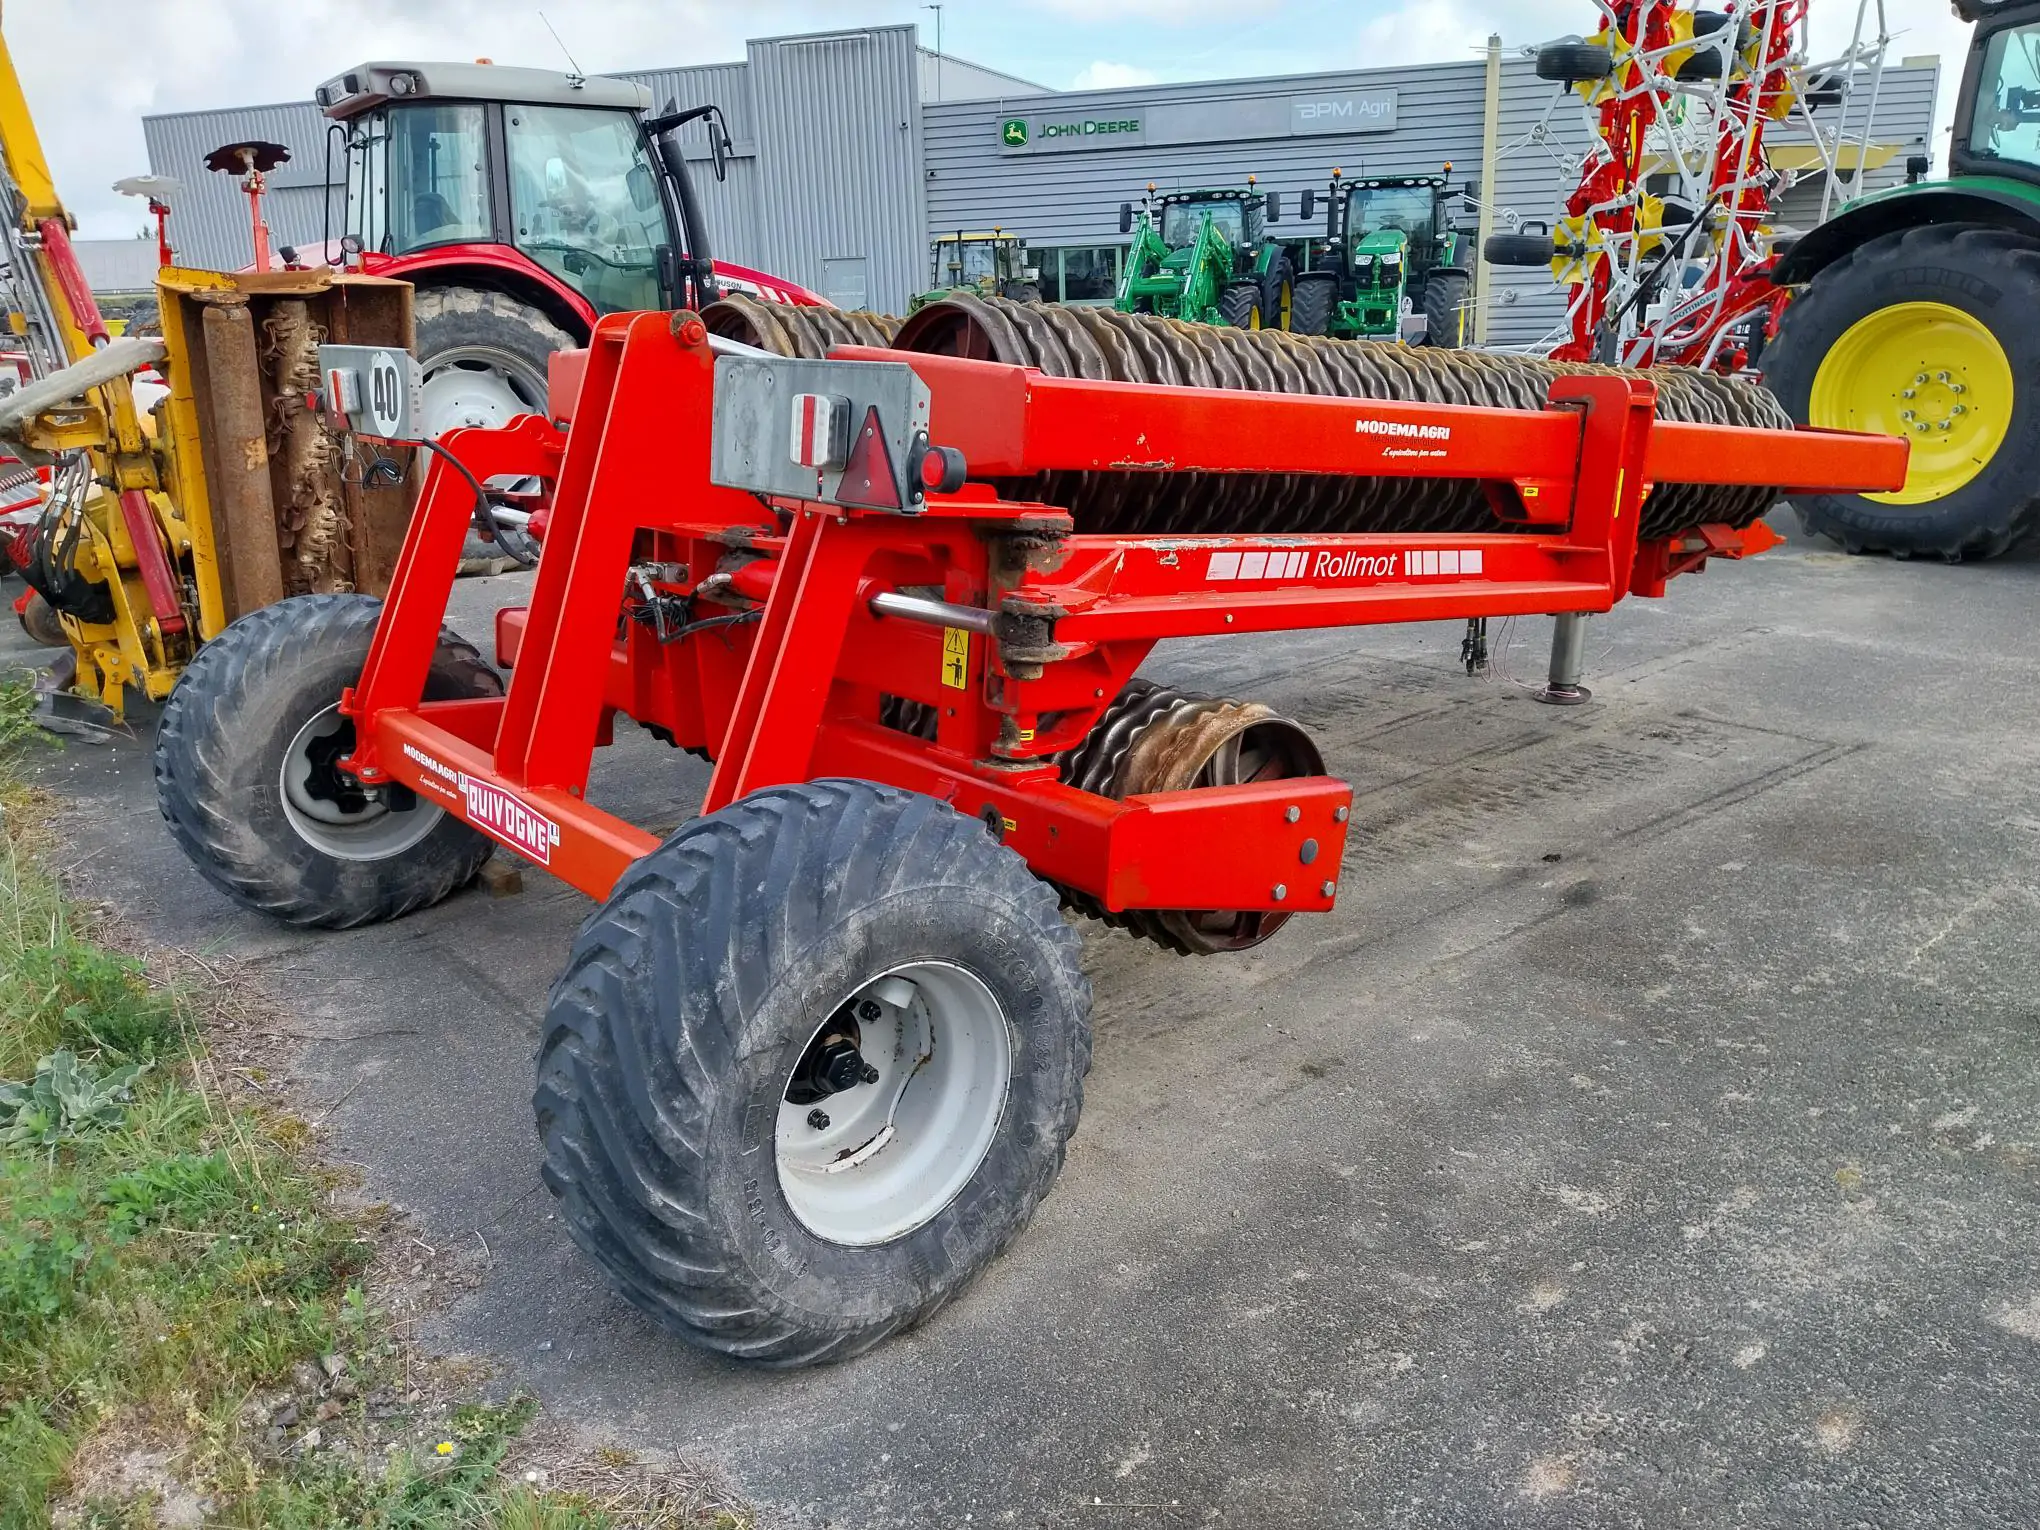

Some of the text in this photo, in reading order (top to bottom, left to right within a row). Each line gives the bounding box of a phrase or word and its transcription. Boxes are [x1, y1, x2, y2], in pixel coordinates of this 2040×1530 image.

[1294, 98, 1391, 119] BPM Agri
[1037, 120, 1140, 139] JOHN DEERE
[374, 366, 399, 422] 40
[1312, 551, 1398, 578] Rollmot
[469, 784, 546, 853] QUIVOGNE
